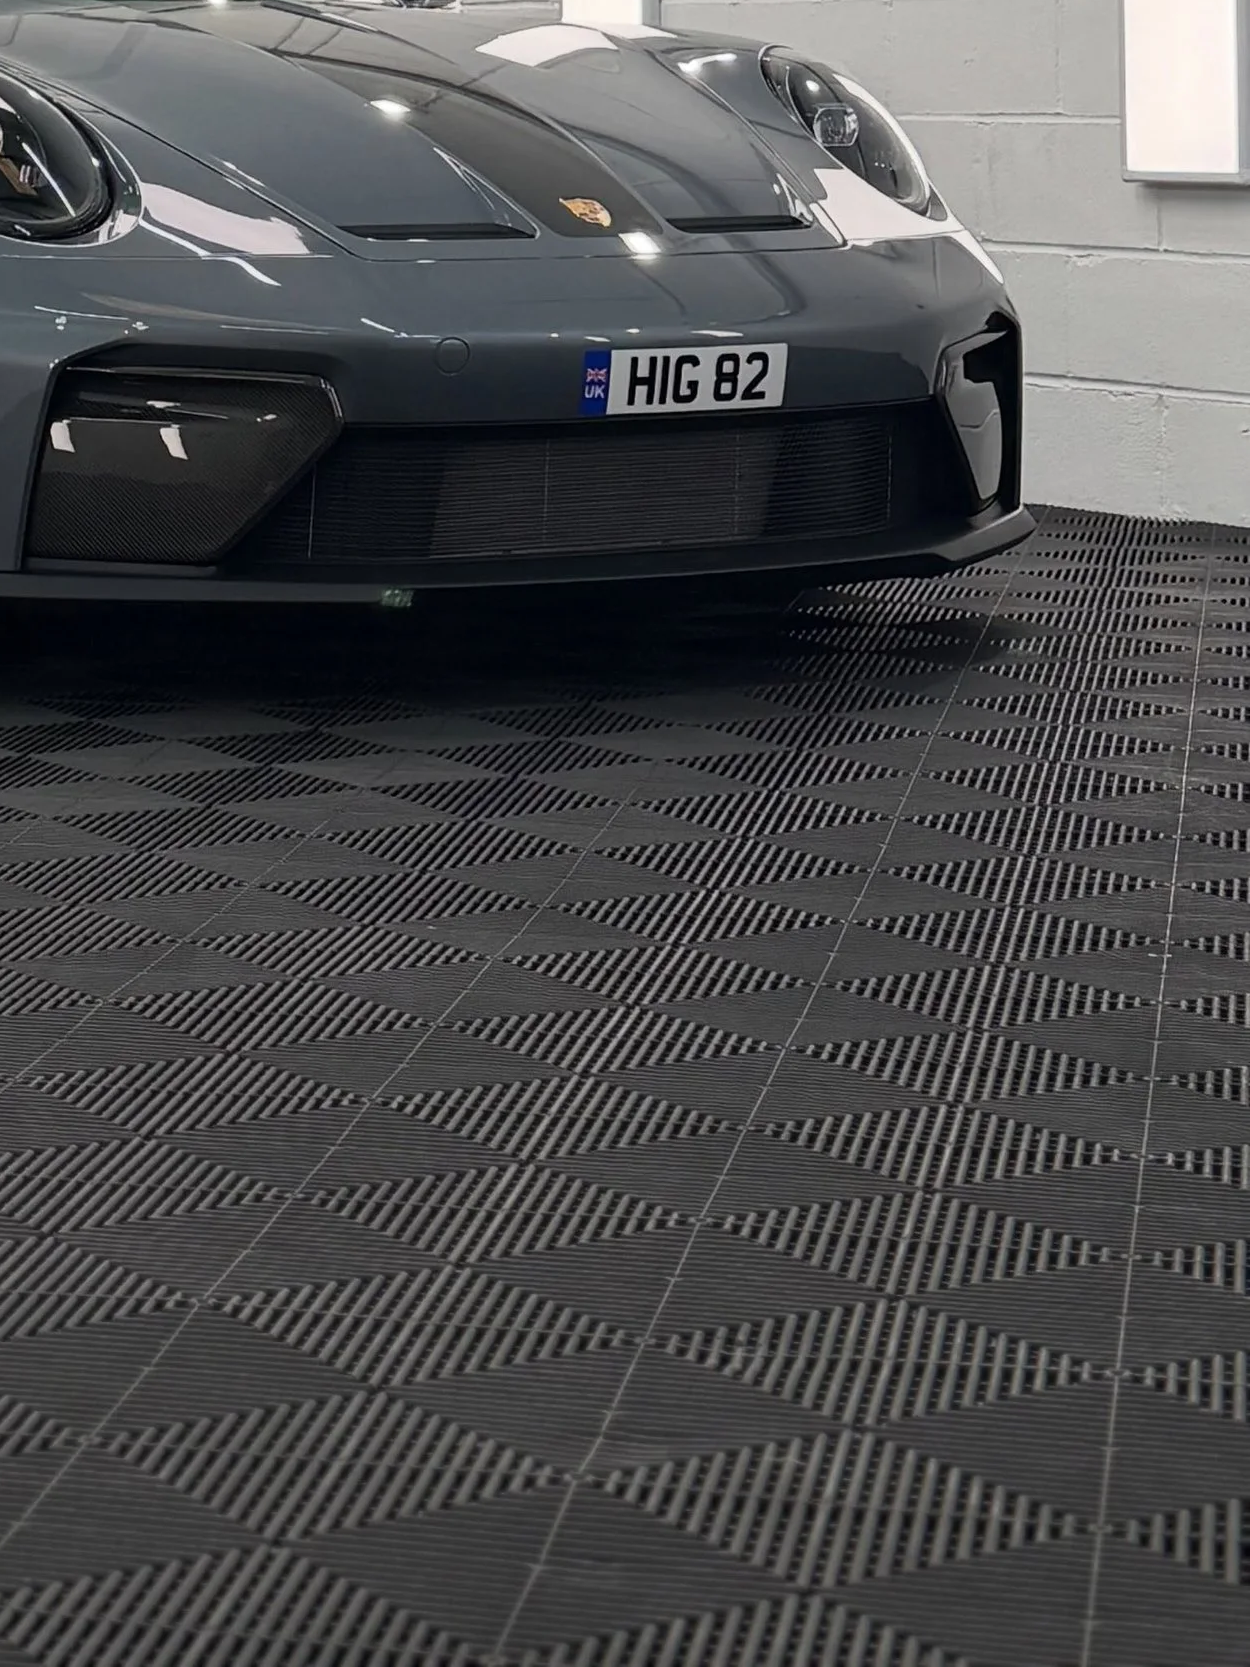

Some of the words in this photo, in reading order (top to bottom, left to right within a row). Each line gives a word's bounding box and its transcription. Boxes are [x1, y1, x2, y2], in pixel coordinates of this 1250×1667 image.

[584, 385, 605, 399] UK
[626, 354, 701, 406] HIG
[712, 351, 770, 403] 82
